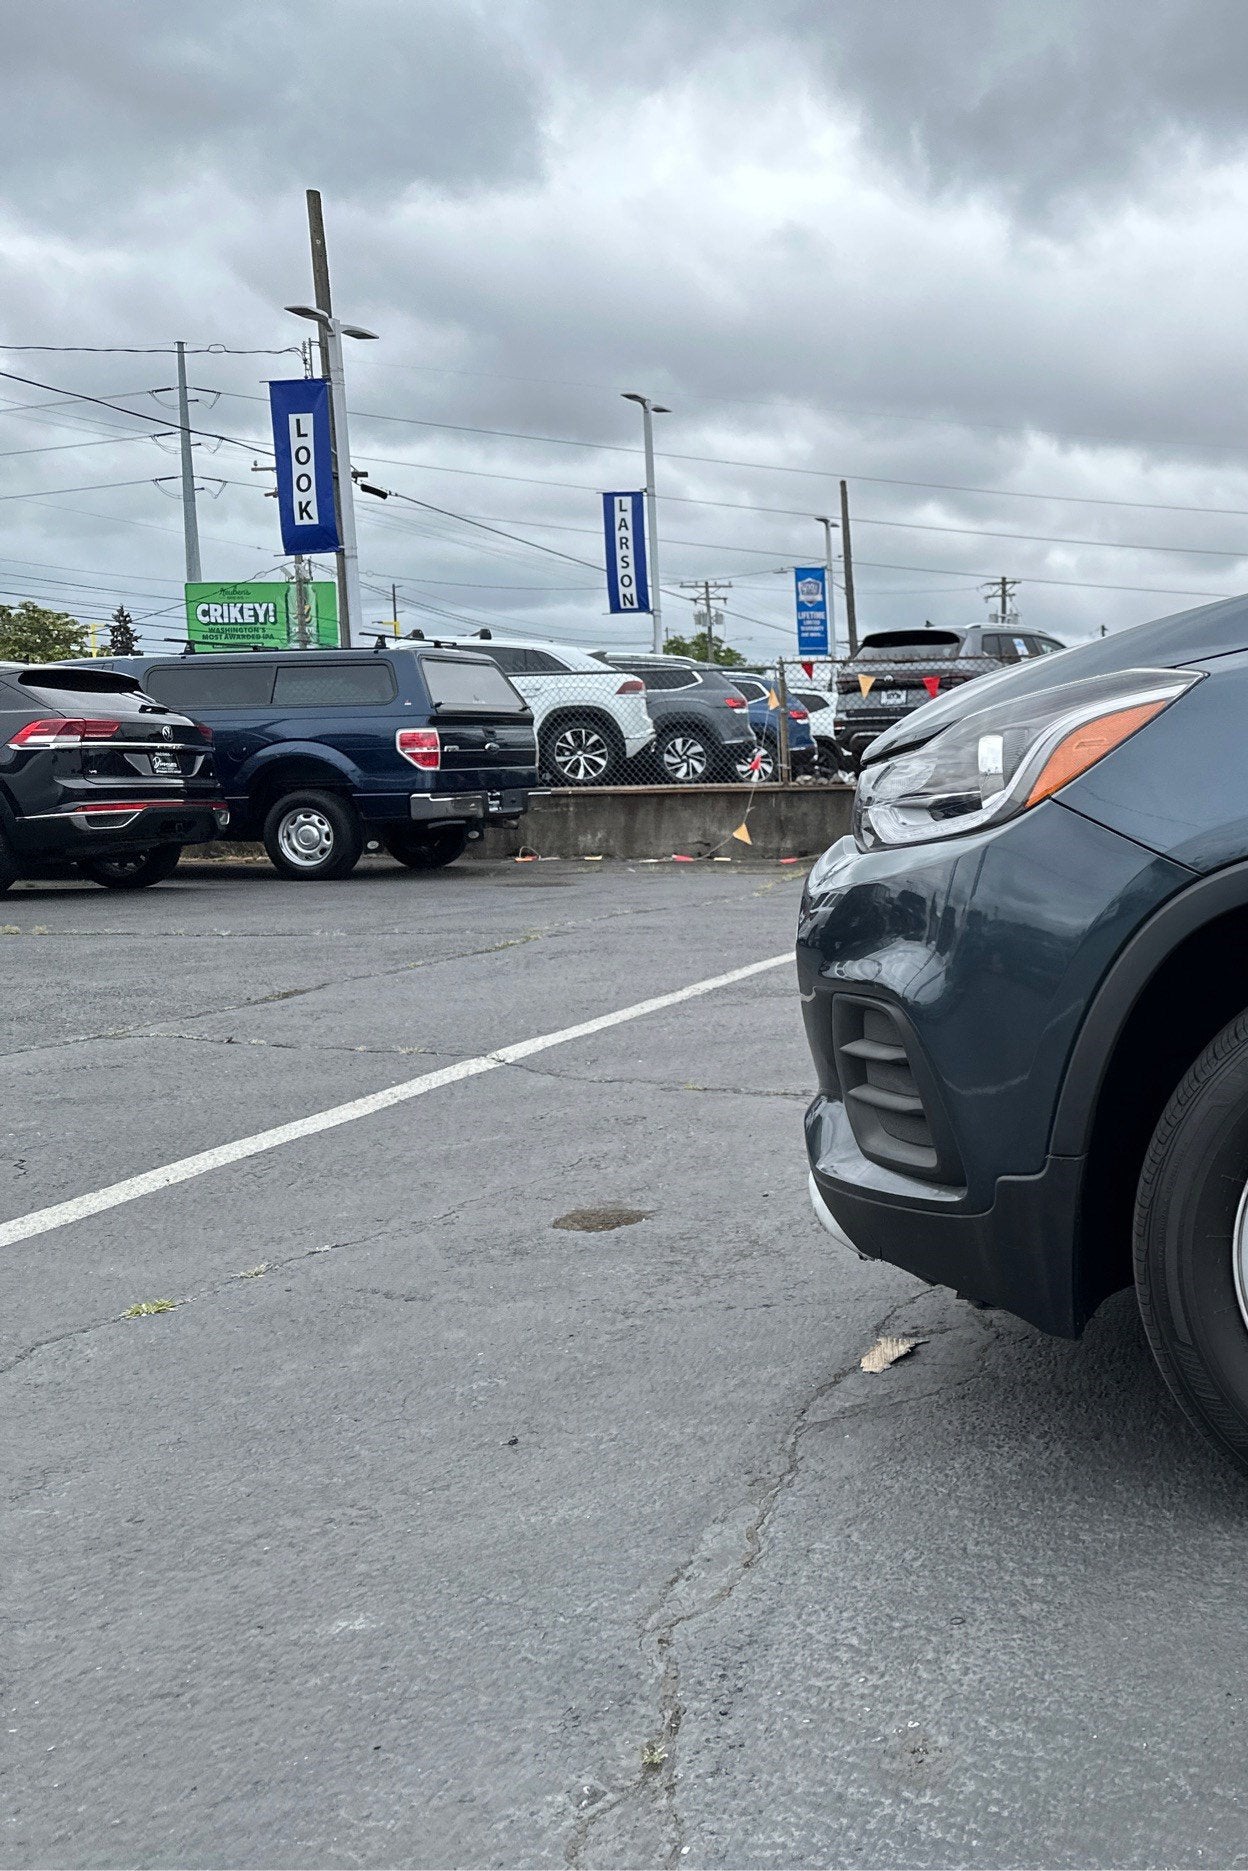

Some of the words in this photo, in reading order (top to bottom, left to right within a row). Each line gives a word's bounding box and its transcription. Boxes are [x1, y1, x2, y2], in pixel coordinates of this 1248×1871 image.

[294, 418, 313, 521] LOOK
[617, 499, 635, 607] LARSON
[196, 602, 277, 625] CRIKEY!
